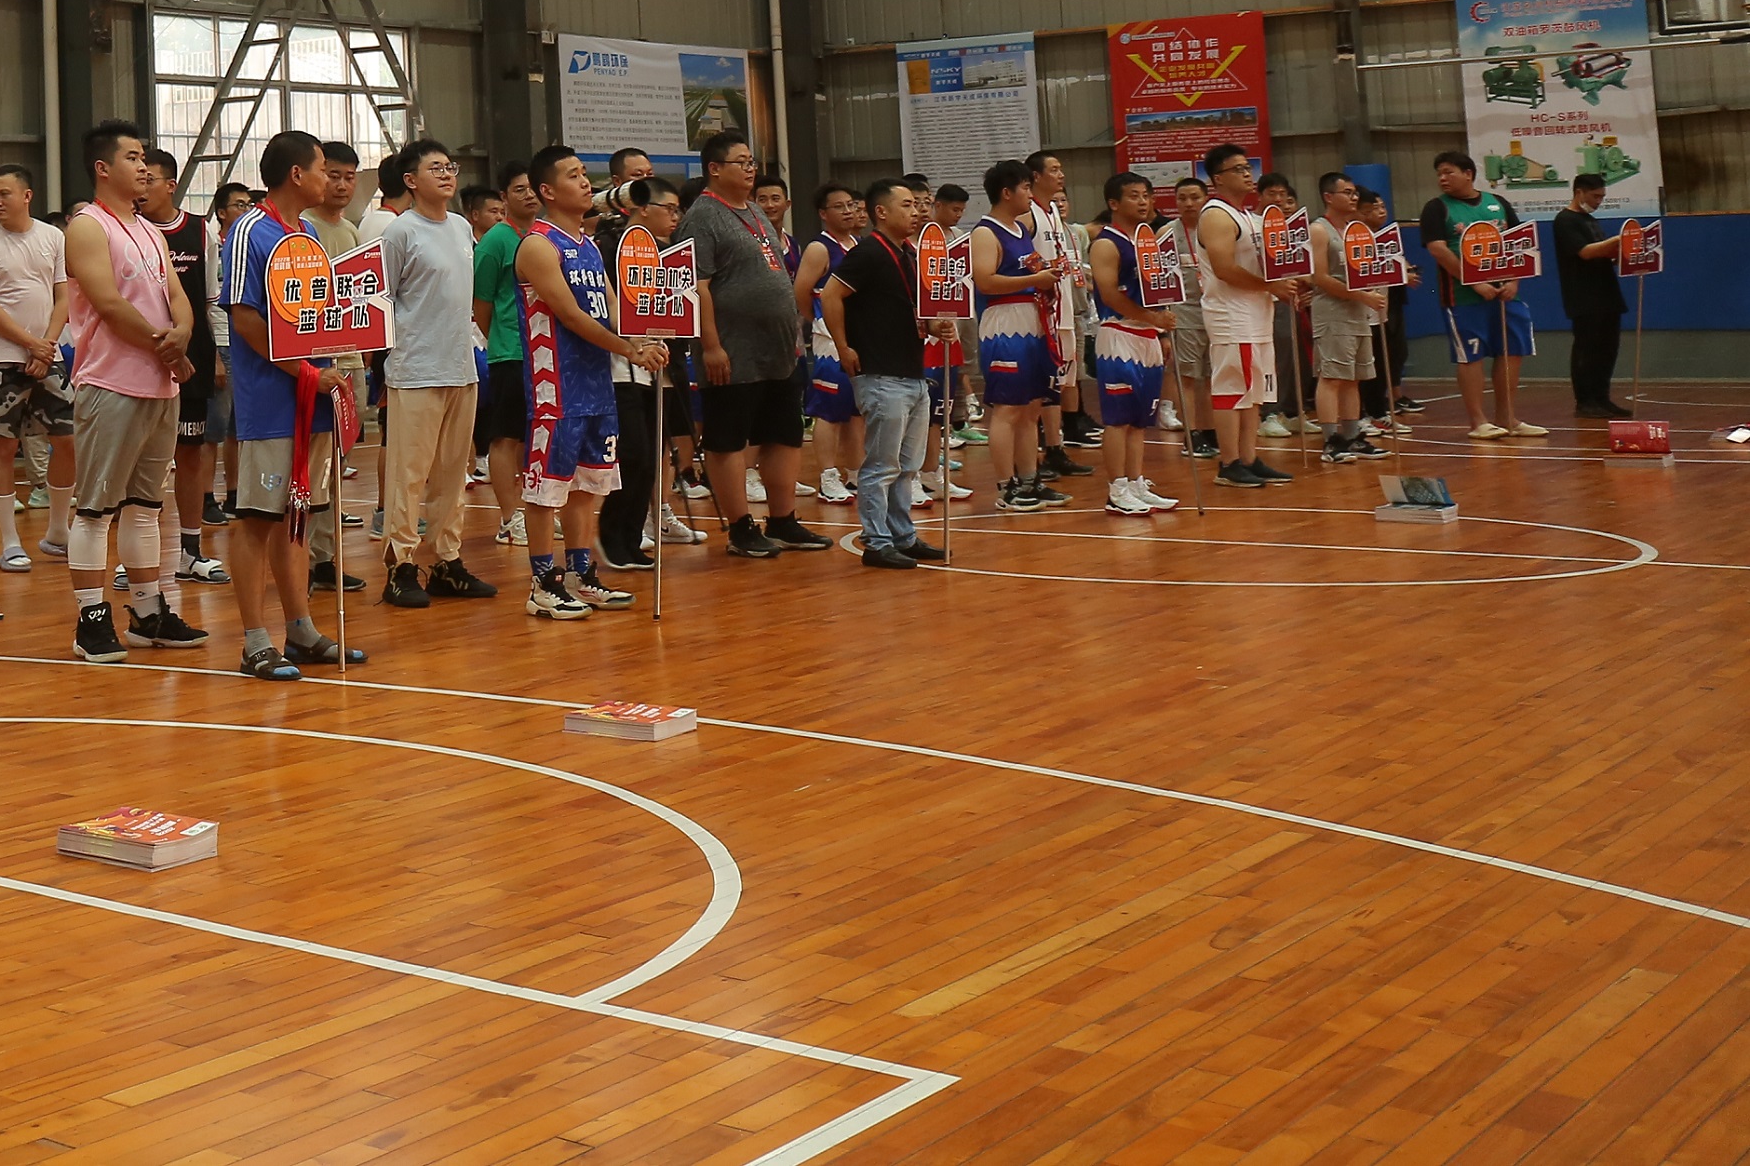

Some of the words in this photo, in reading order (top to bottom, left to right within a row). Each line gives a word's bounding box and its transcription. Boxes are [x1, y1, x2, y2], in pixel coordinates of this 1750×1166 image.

[1469, 238, 1532, 259] 泰源环保
[1358, 260, 1396, 277] 篮球队
[1479, 254, 1528, 273] 篮球队
[283, 270, 380, 304] 优普联合
[626, 265, 692, 290] 环科园机关
[930, 280, 964, 301] 篮球队
[586, 291, 609, 319] 30
[636, 292, 684, 317] 篮球队
[296, 306, 372, 336] 篮球队
[1468, 338, 1480, 355] 7
